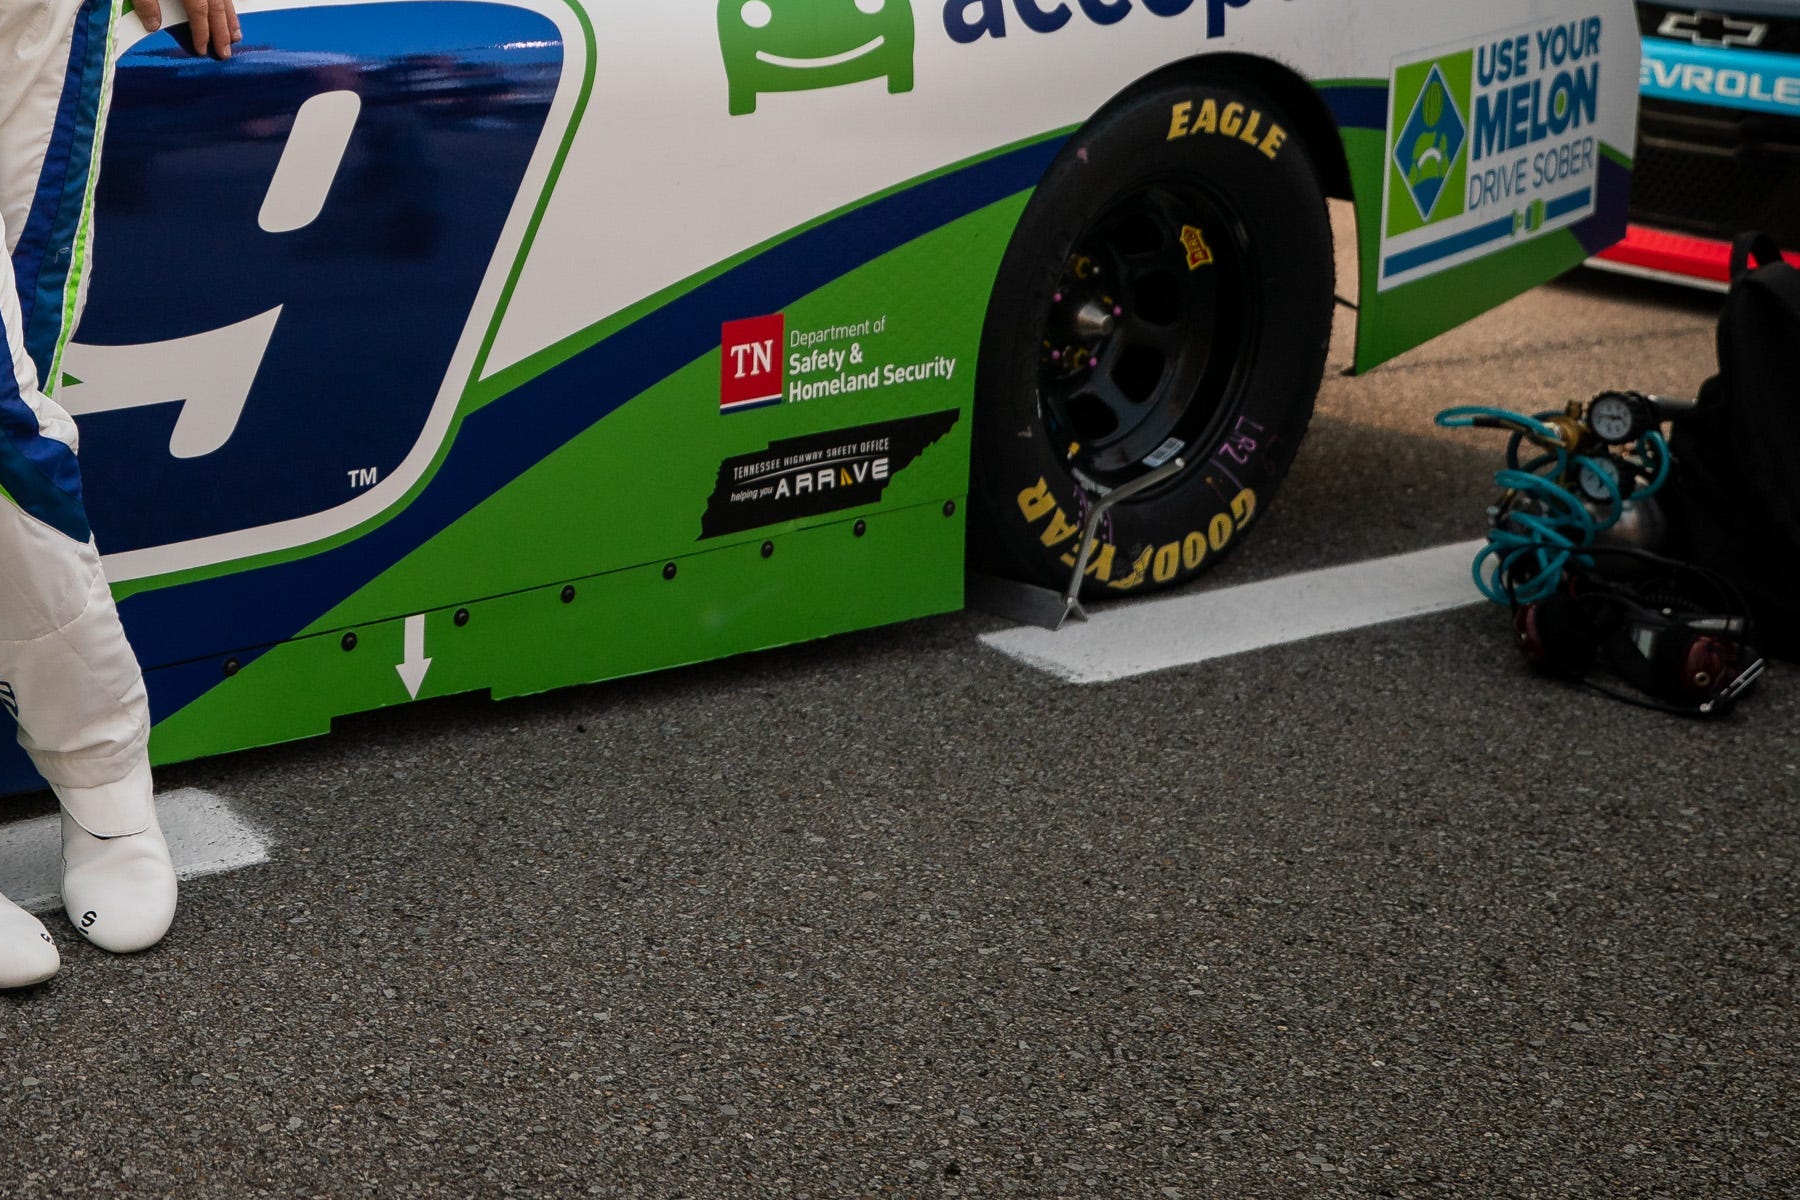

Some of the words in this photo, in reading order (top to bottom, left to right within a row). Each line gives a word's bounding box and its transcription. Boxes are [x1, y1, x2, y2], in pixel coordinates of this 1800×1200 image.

[1477, 33, 1530, 87] USE
[1536, 15, 1601, 71] YOUR
[1166, 98, 1287, 161] EAGLE
[1472, 61, 1600, 161] MELON
[1468, 157, 1528, 211] DRIVE
[1532, 136, 1593, 188] SOBER
[790, 319, 870, 348] Department
[874, 315, 887, 333] of
[730, 339, 774, 379] TN
[789, 346, 847, 376] Safety
[850, 342, 863, 365] &
[789, 366, 879, 403] Homeland
[883, 355, 957, 386] Security
[348, 466, 378, 488] TM
[734, 458, 781, 481] TENNESSEE
[783, 450, 823, 469] HIGHWAY
[826, 443, 858, 458] SAFETY
[860, 437, 890, 454] OFFICE
[730, 487, 758, 503] helping
[759, 485, 774, 498] you
